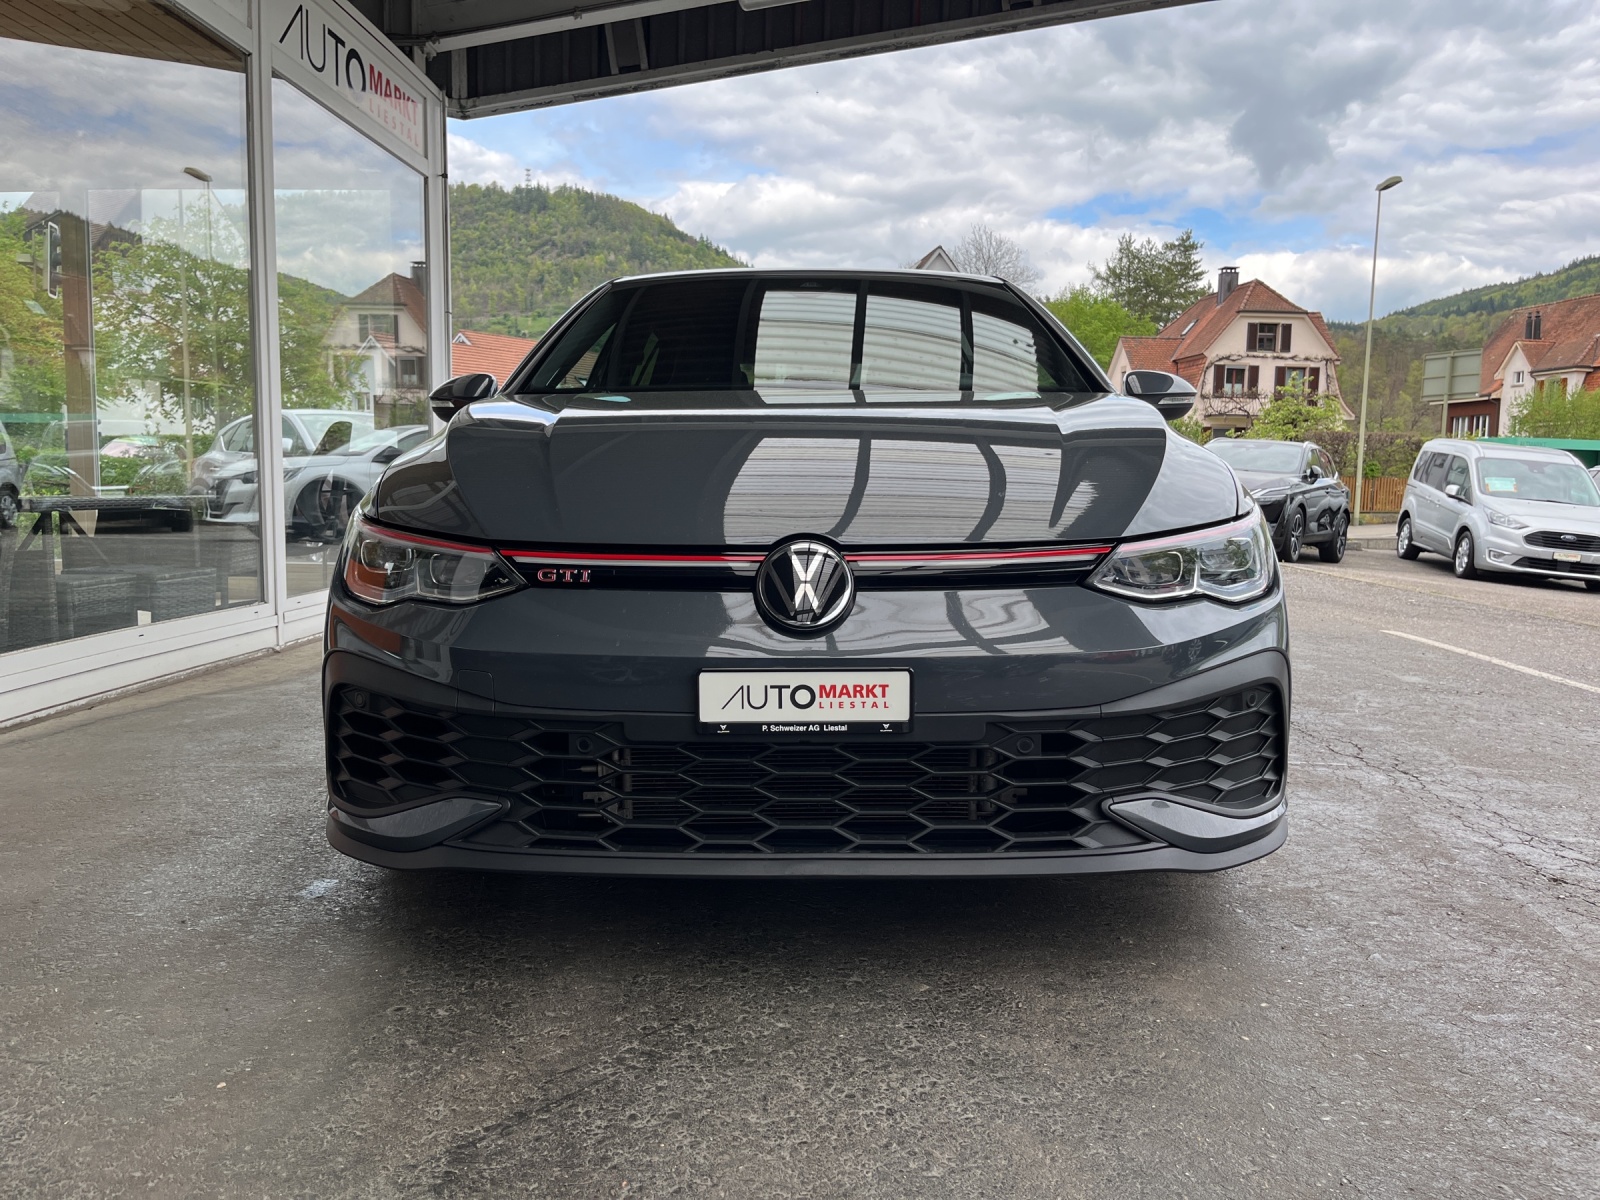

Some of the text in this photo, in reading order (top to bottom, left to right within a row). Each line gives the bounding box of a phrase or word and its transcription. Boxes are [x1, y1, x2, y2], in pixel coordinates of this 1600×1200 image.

[369, 98, 419, 147] LIESTAL
[537, 568, 591, 583] GTI
[818, 701, 890, 709] LIESTAL
[770, 724, 807, 732] Schweizer
[808, 724, 820, 732] AG
[823, 724, 848, 732] Liestal
